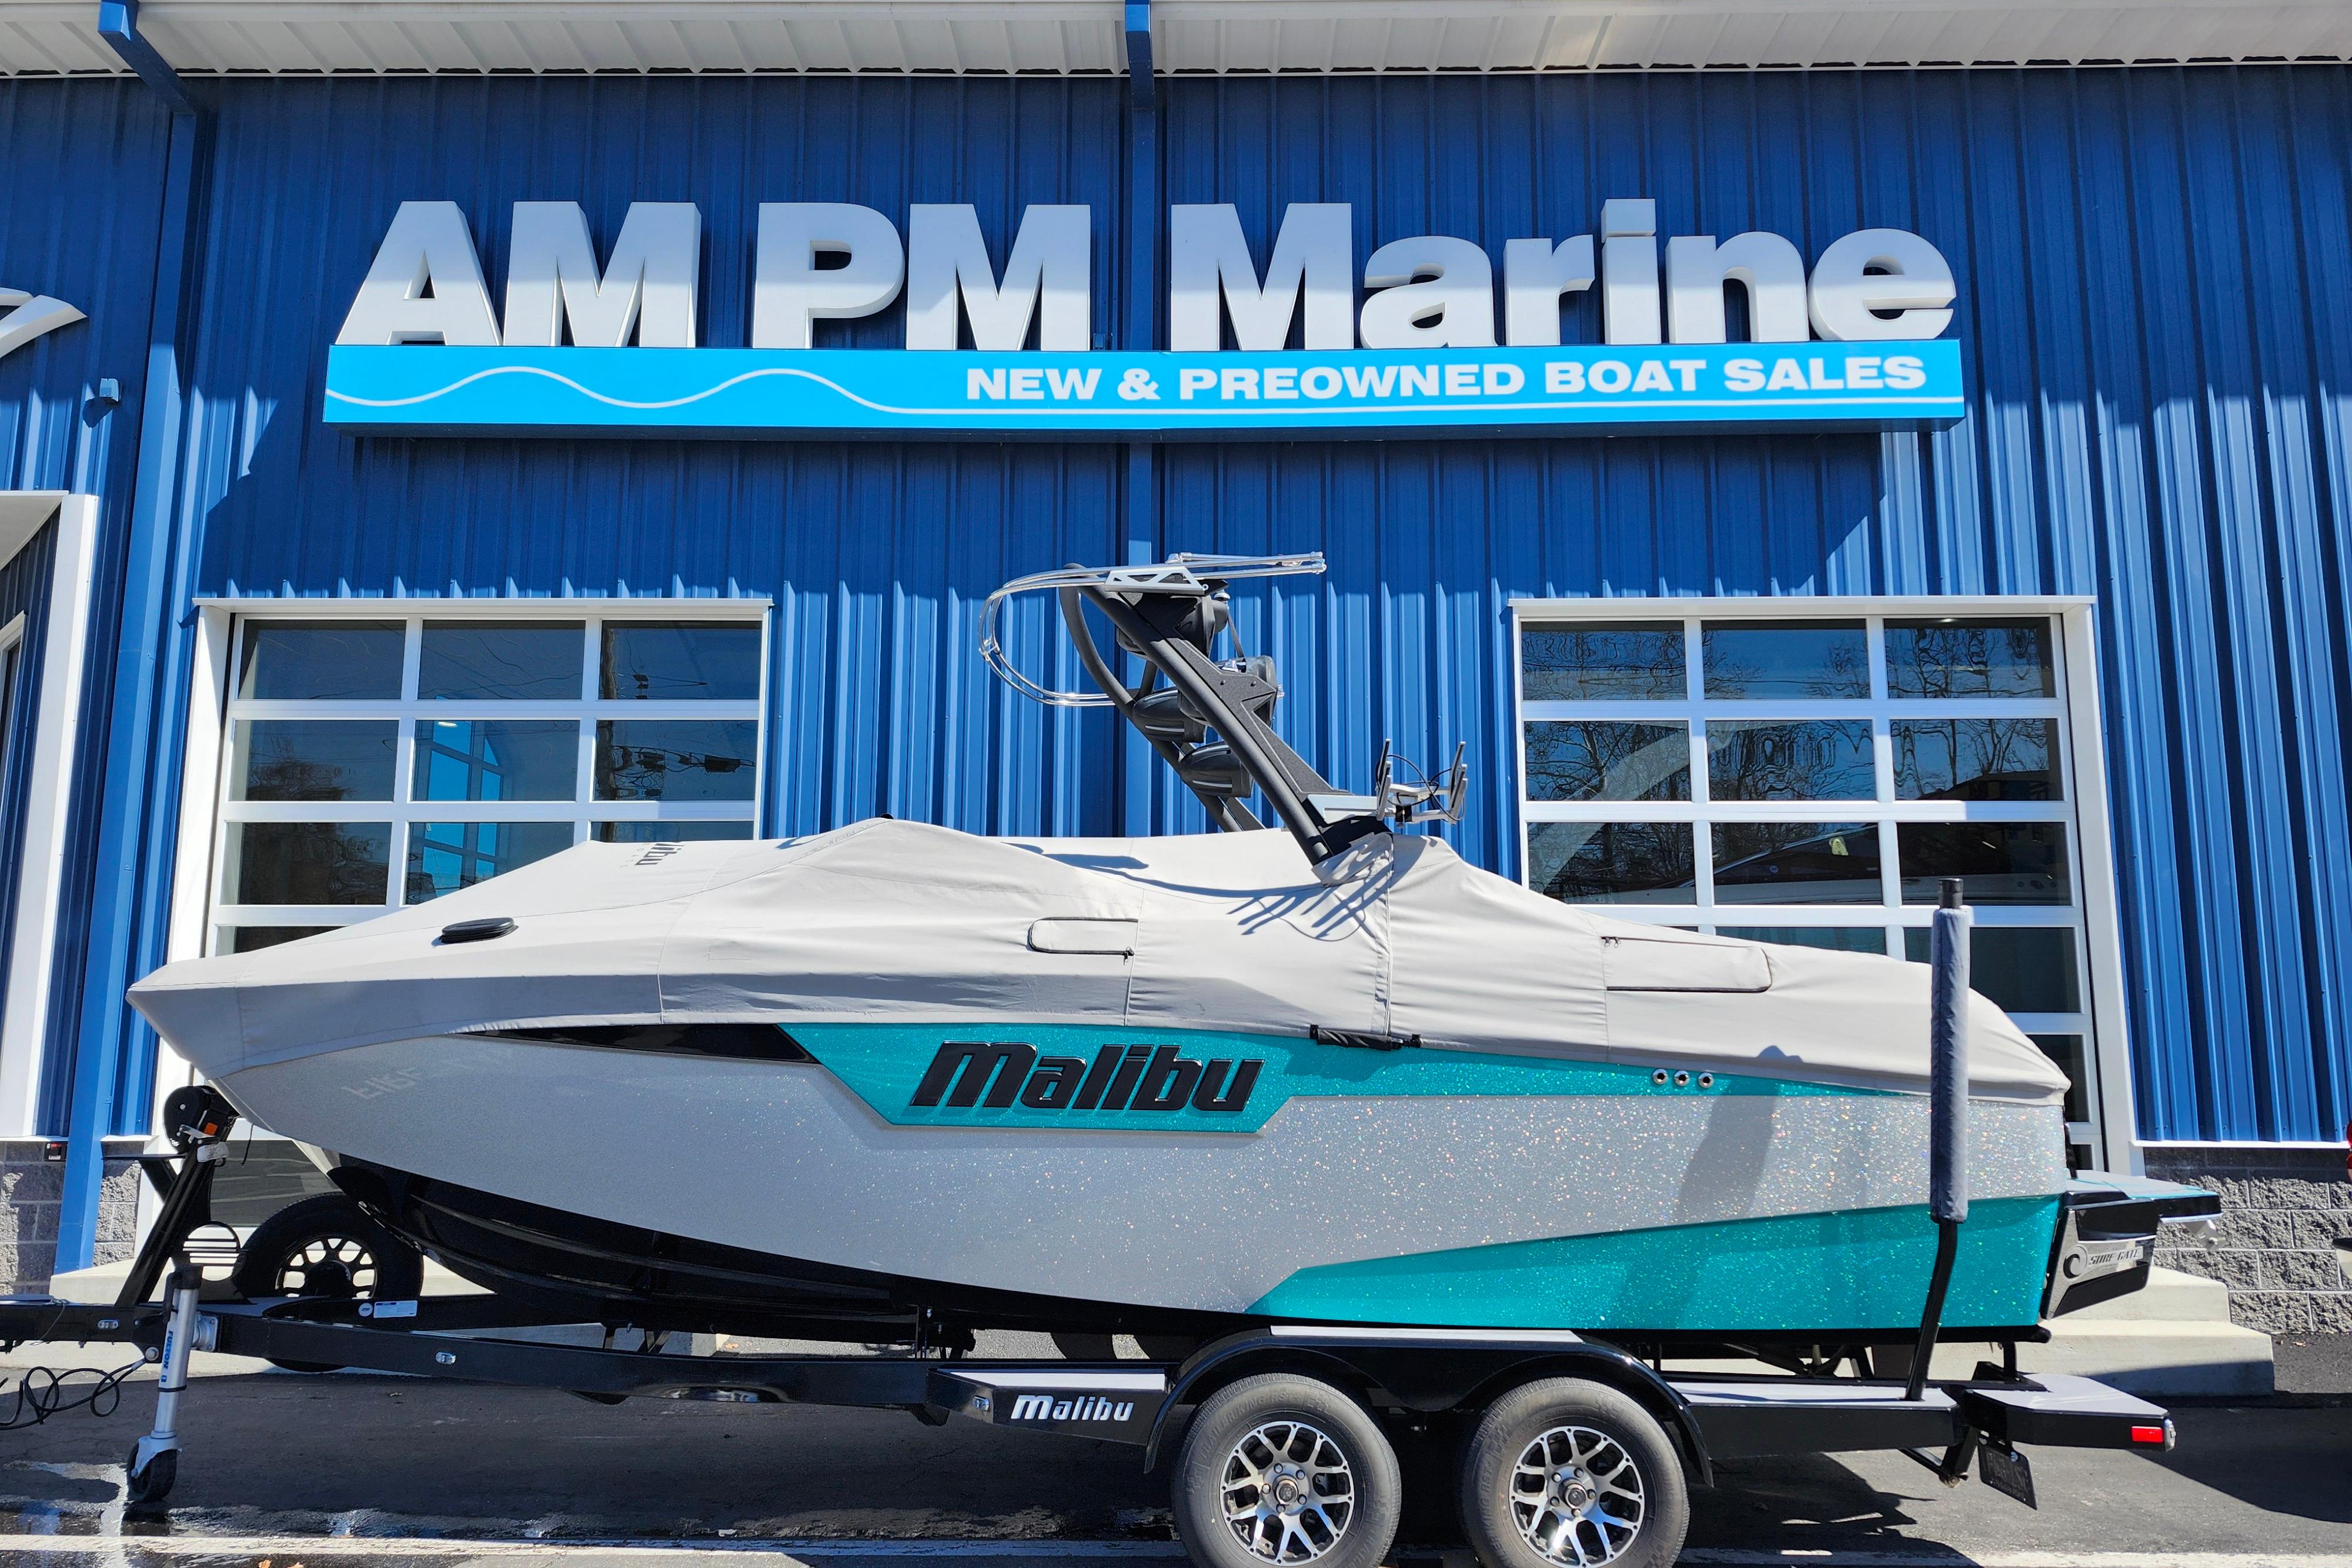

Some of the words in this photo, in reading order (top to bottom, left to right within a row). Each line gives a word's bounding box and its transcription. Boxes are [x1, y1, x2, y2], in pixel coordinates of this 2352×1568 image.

[336, 200, 701, 347] AM
[752, 202, 1091, 352] PM
[1170, 198, 1956, 352] Marine
[967, 368, 1102, 400] NEW
[1117, 367, 1162, 401] &
[1180, 365, 1525, 400] PREOWNED
[1545, 359, 1706, 393] BOAT
[1723, 356, 1927, 393] SALES
[910, 1040, 1265, 1112] Malibu
[2089, 1252, 2116, 1266] SURF
[2117, 1248, 2141, 1261] GATE
[163, 1330, 173, 1370] FULTON
[1010, 1394, 1135, 1422] Malibu
[1234, 1395, 1266, 1415] KING
